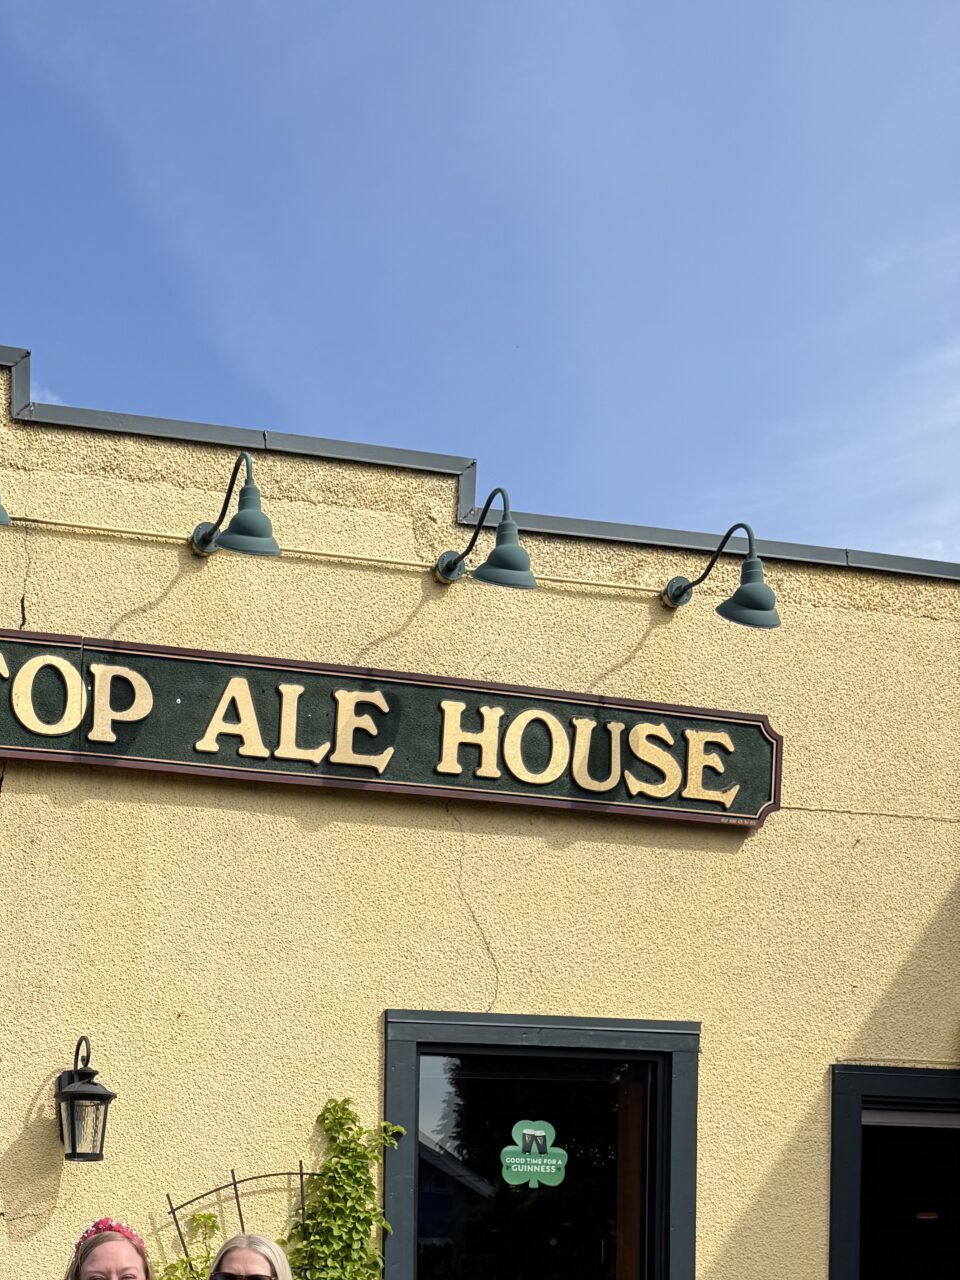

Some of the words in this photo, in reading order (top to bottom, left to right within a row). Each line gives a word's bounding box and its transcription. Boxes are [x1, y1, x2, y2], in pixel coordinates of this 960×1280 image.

[194, 677, 394, 775] ALE
[436, 700, 739, 808] HOUSE
[511, 1164, 556, 1173] GUINNESS
